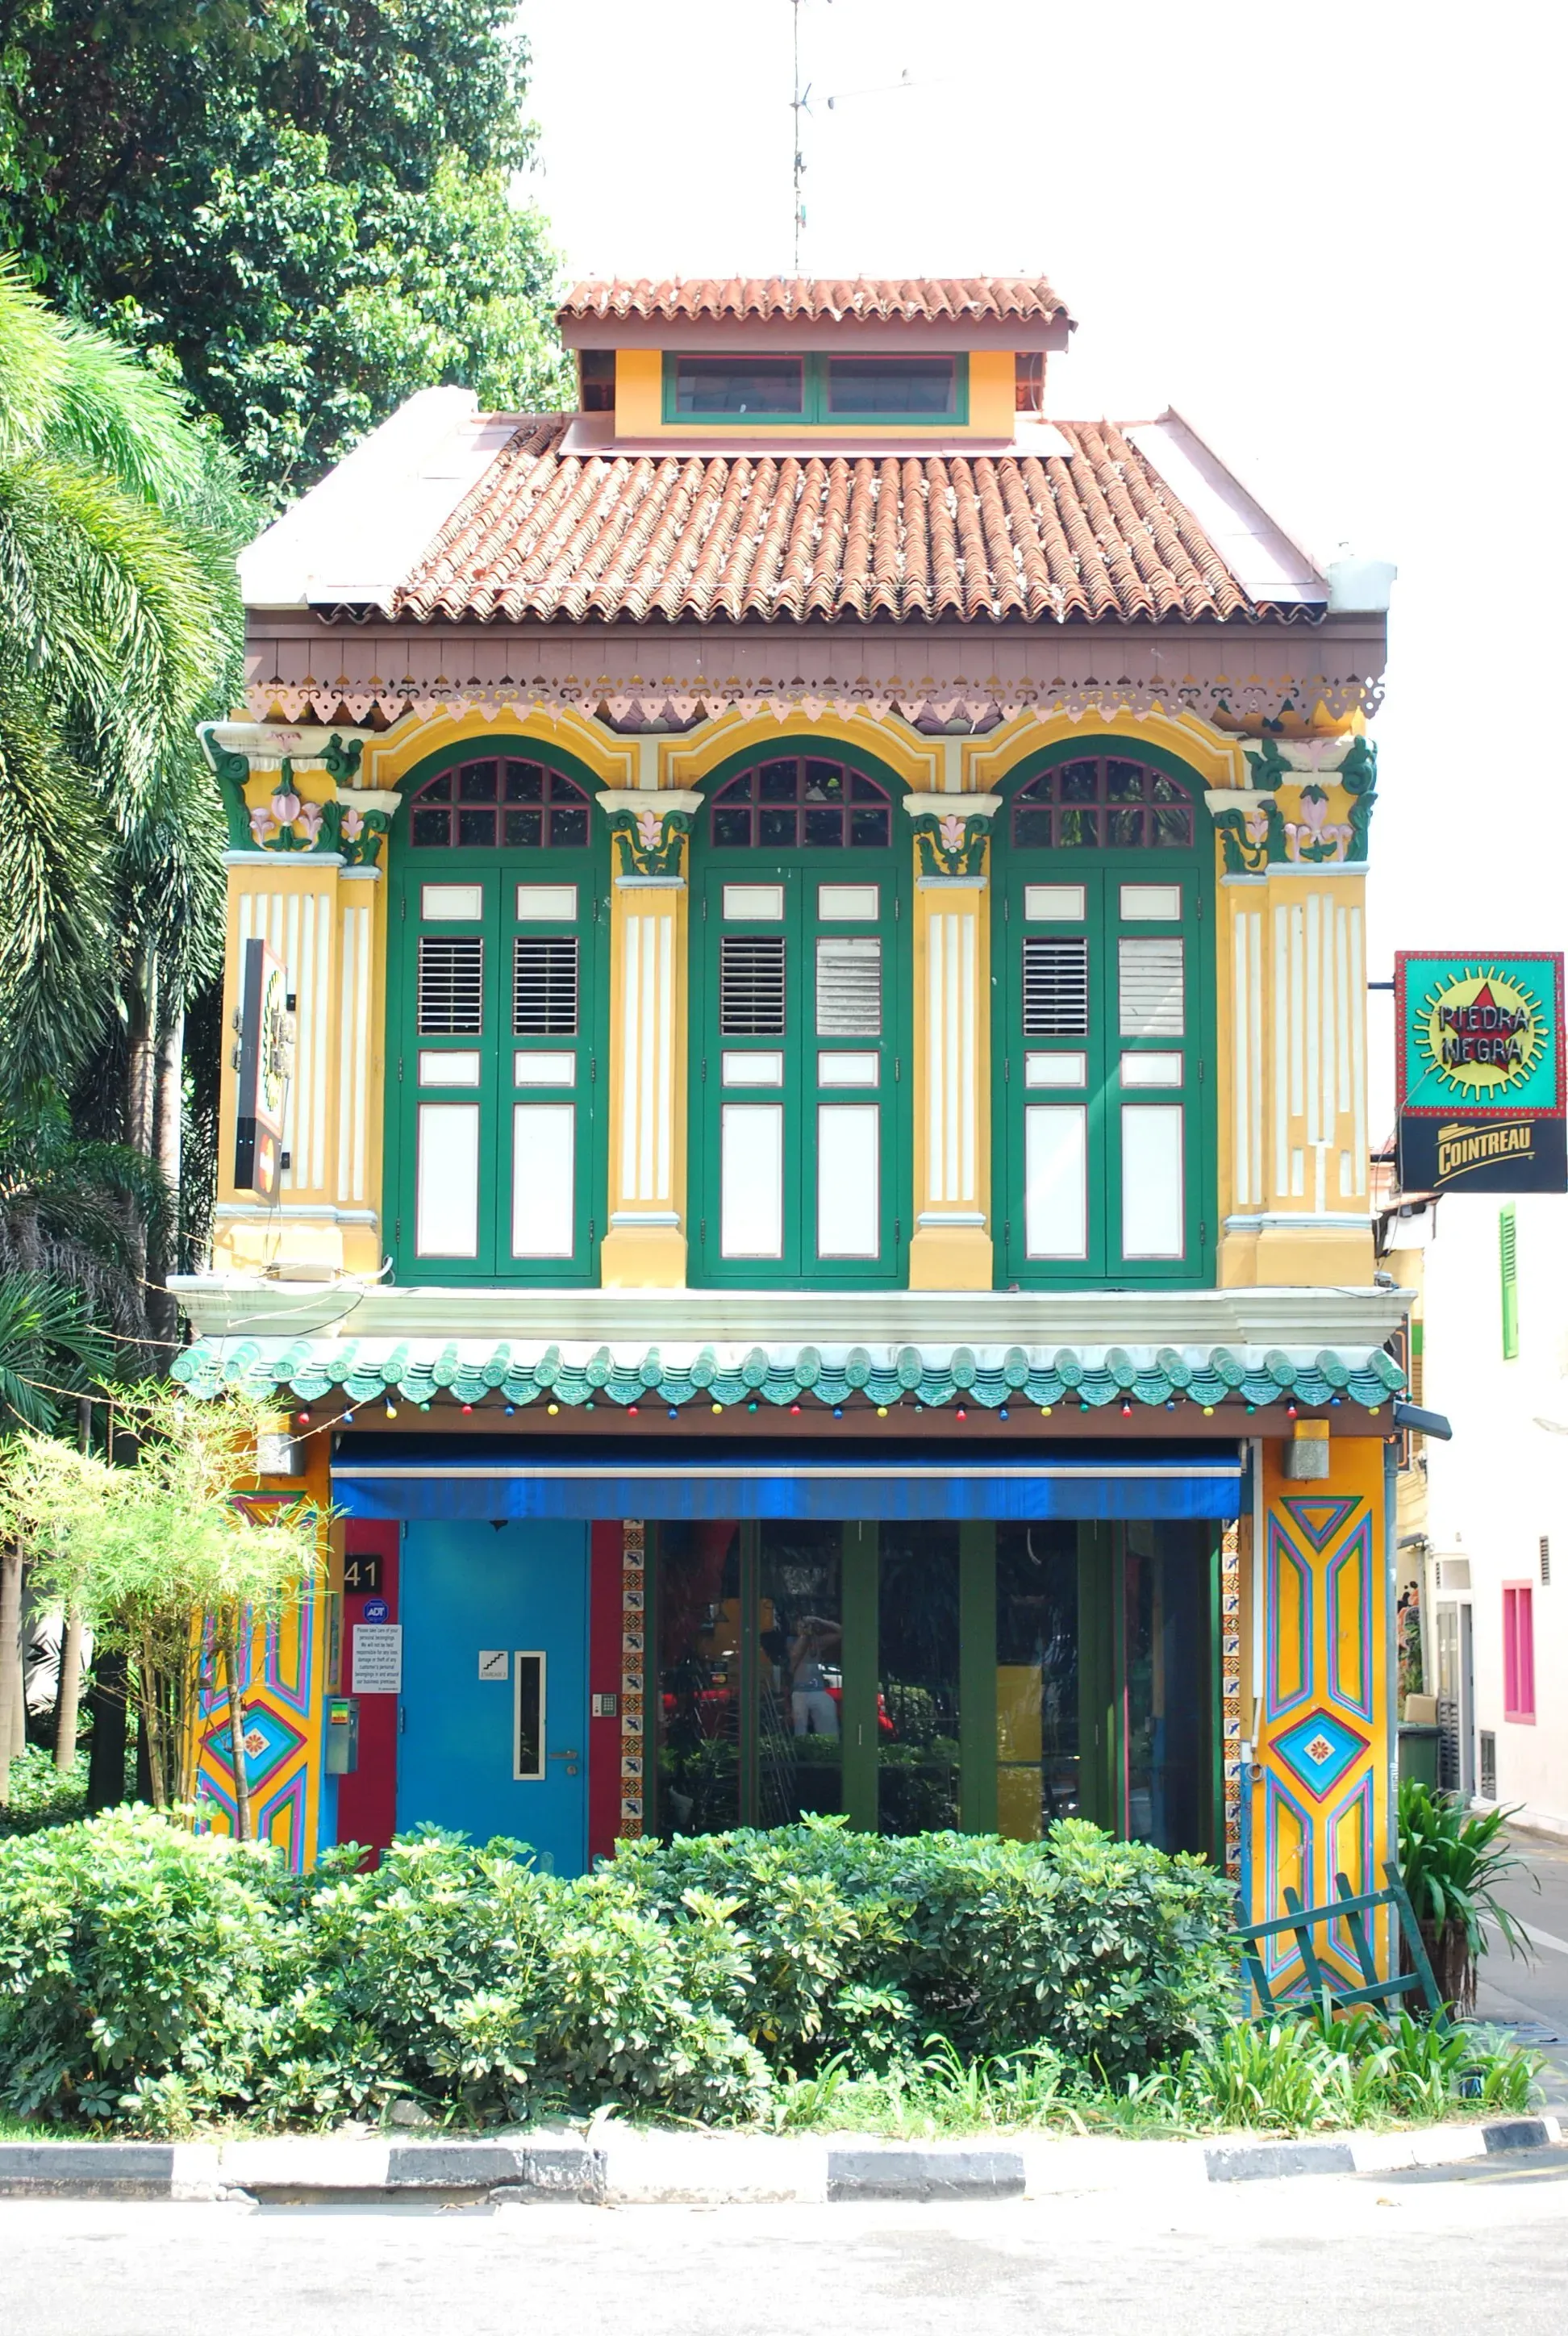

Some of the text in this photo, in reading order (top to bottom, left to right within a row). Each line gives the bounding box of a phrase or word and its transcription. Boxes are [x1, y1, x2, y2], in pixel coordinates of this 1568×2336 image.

[1438, 1005, 1530, 1032] PIEDRA
[1442, 1037, 1523, 1064] NEGRA
[1439, 1128, 1531, 1175] COINTREAU
[344, 1561, 376, 1587] 41
[367, 1607, 385, 1616] ADT
